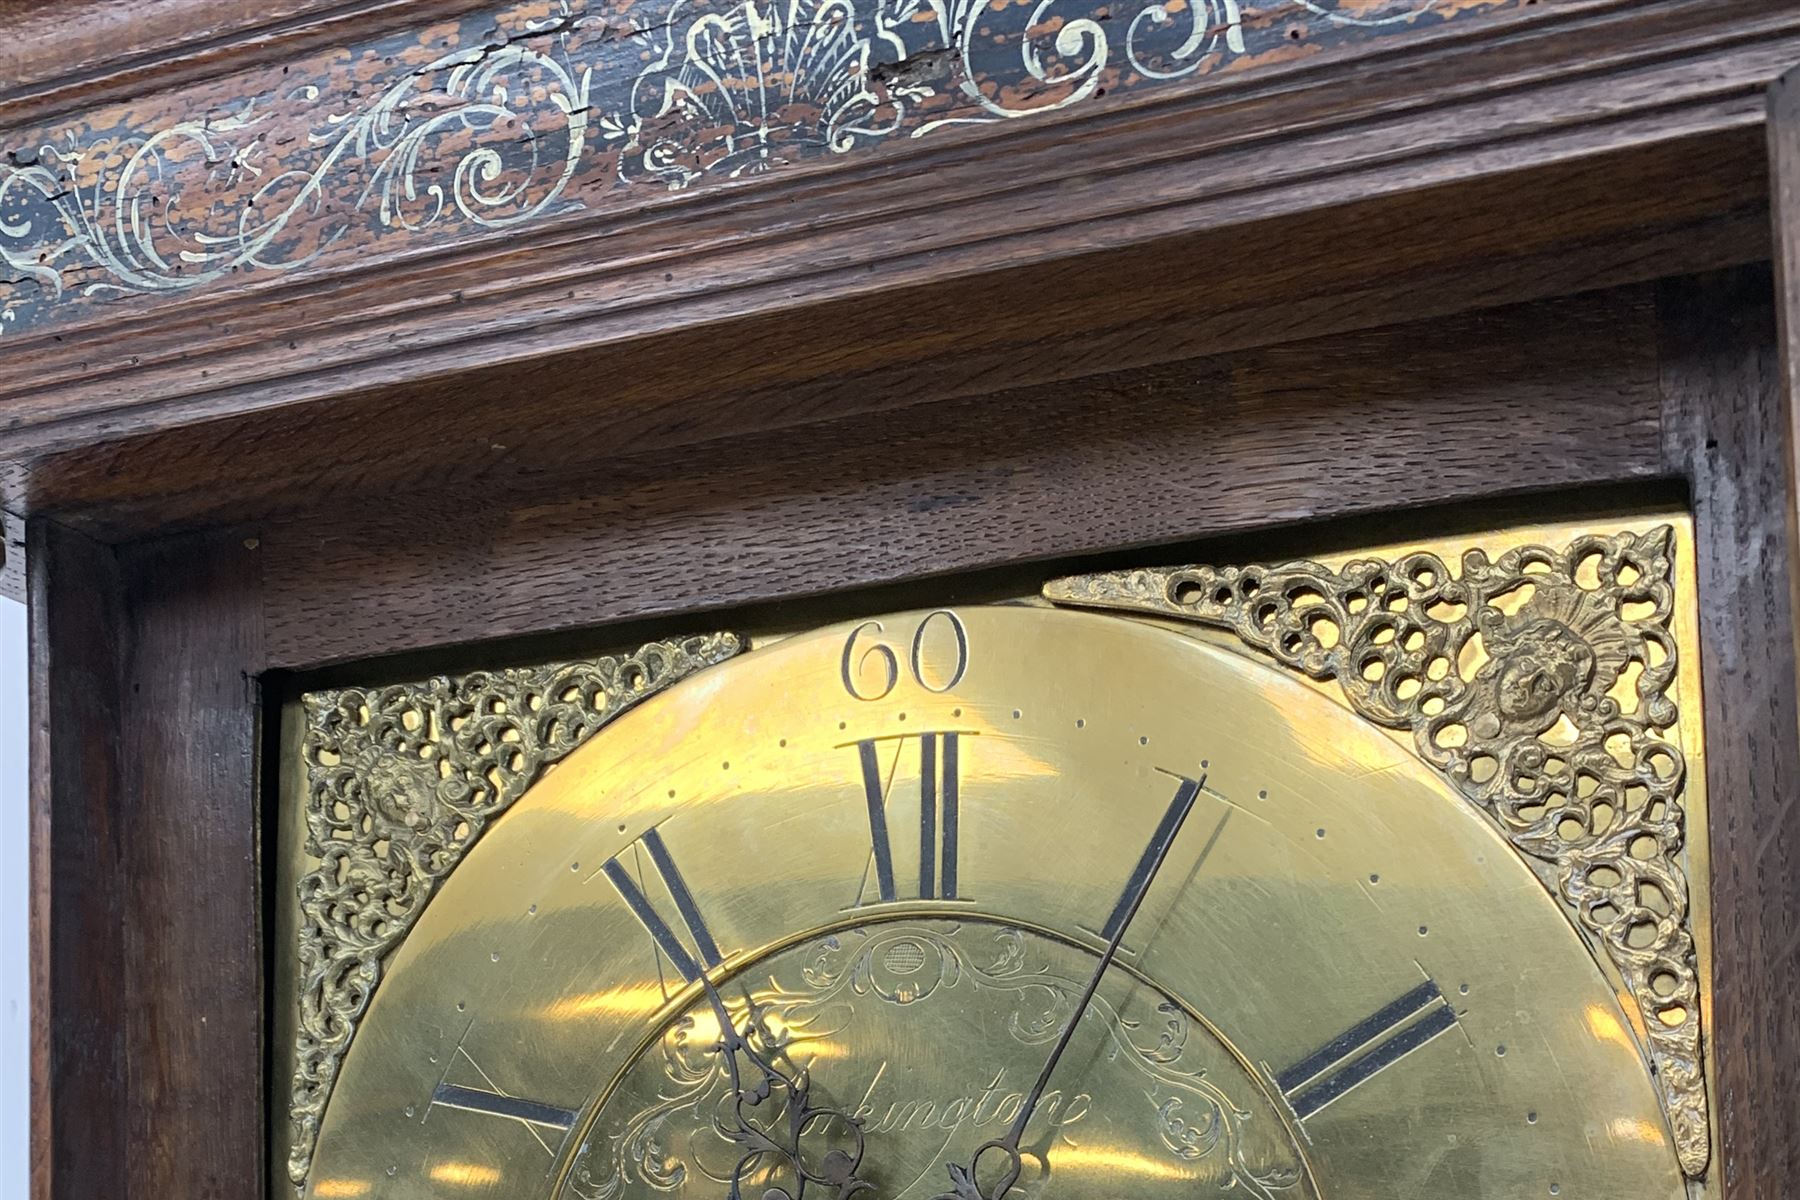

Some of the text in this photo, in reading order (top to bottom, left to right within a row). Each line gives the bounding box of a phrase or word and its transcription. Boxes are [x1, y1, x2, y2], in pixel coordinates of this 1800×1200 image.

[842, 611, 969, 701] 60
[583, 814, 743, 1004] XI
[832, 730, 981, 913] XII
[421, 1017, 590, 1178] X
[1259, 957, 1475, 1146] II
